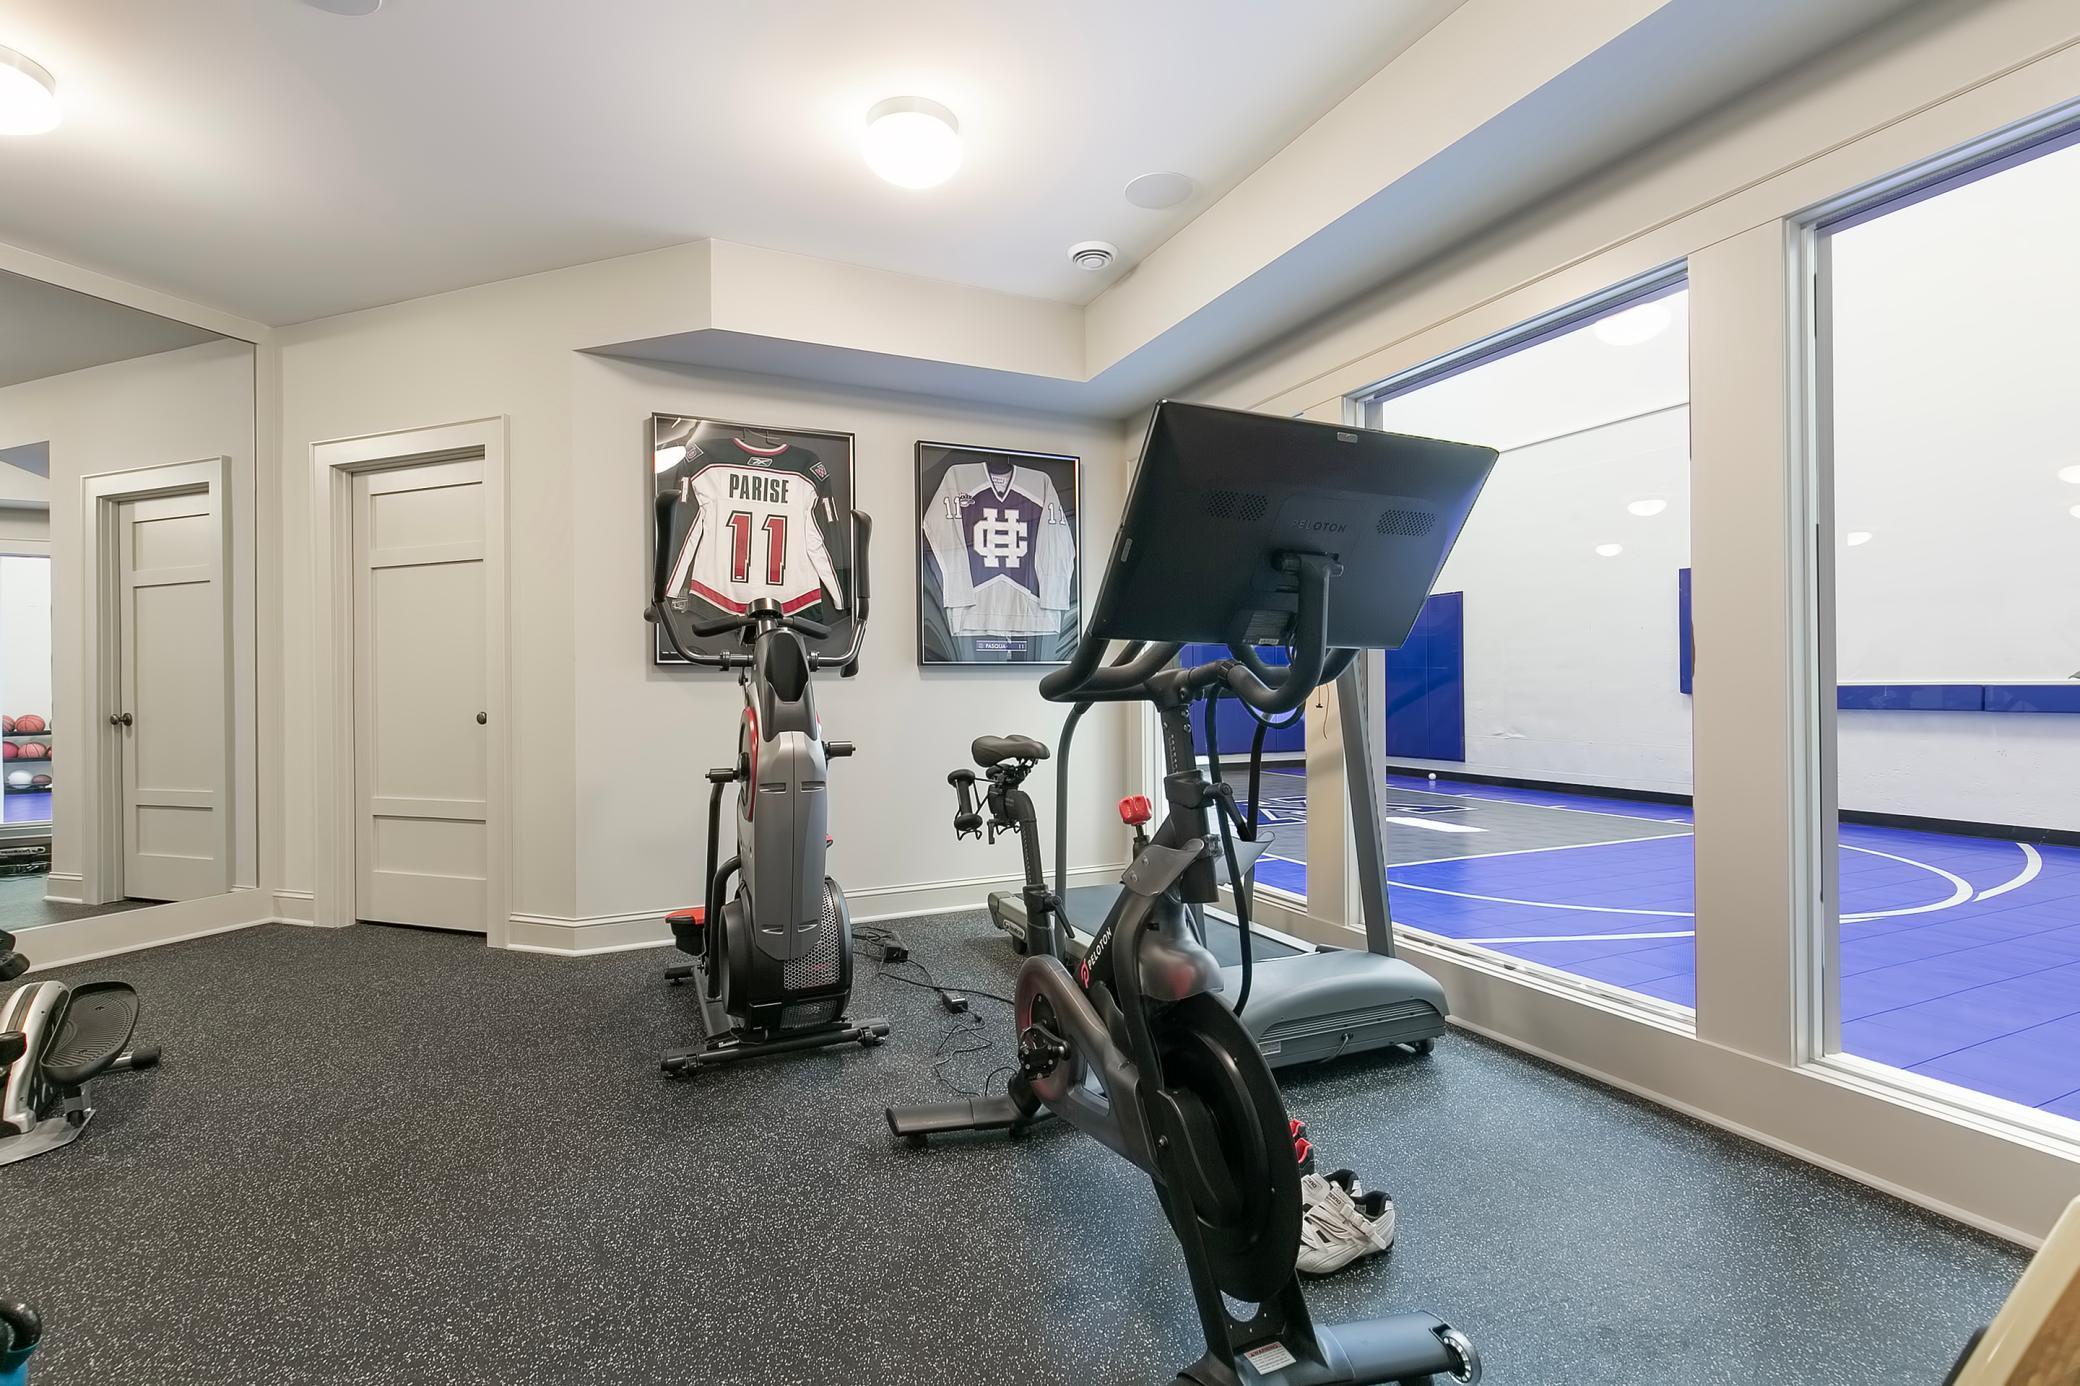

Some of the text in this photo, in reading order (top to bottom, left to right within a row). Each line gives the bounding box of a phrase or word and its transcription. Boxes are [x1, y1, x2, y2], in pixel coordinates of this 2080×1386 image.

[729, 473, 790, 504] PARISE
[943, 496, 963, 519] 11
[1047, 502, 1067, 525] 11
[725, 509, 788, 586] 11
[1087, 926, 1113, 971] PELOTON
